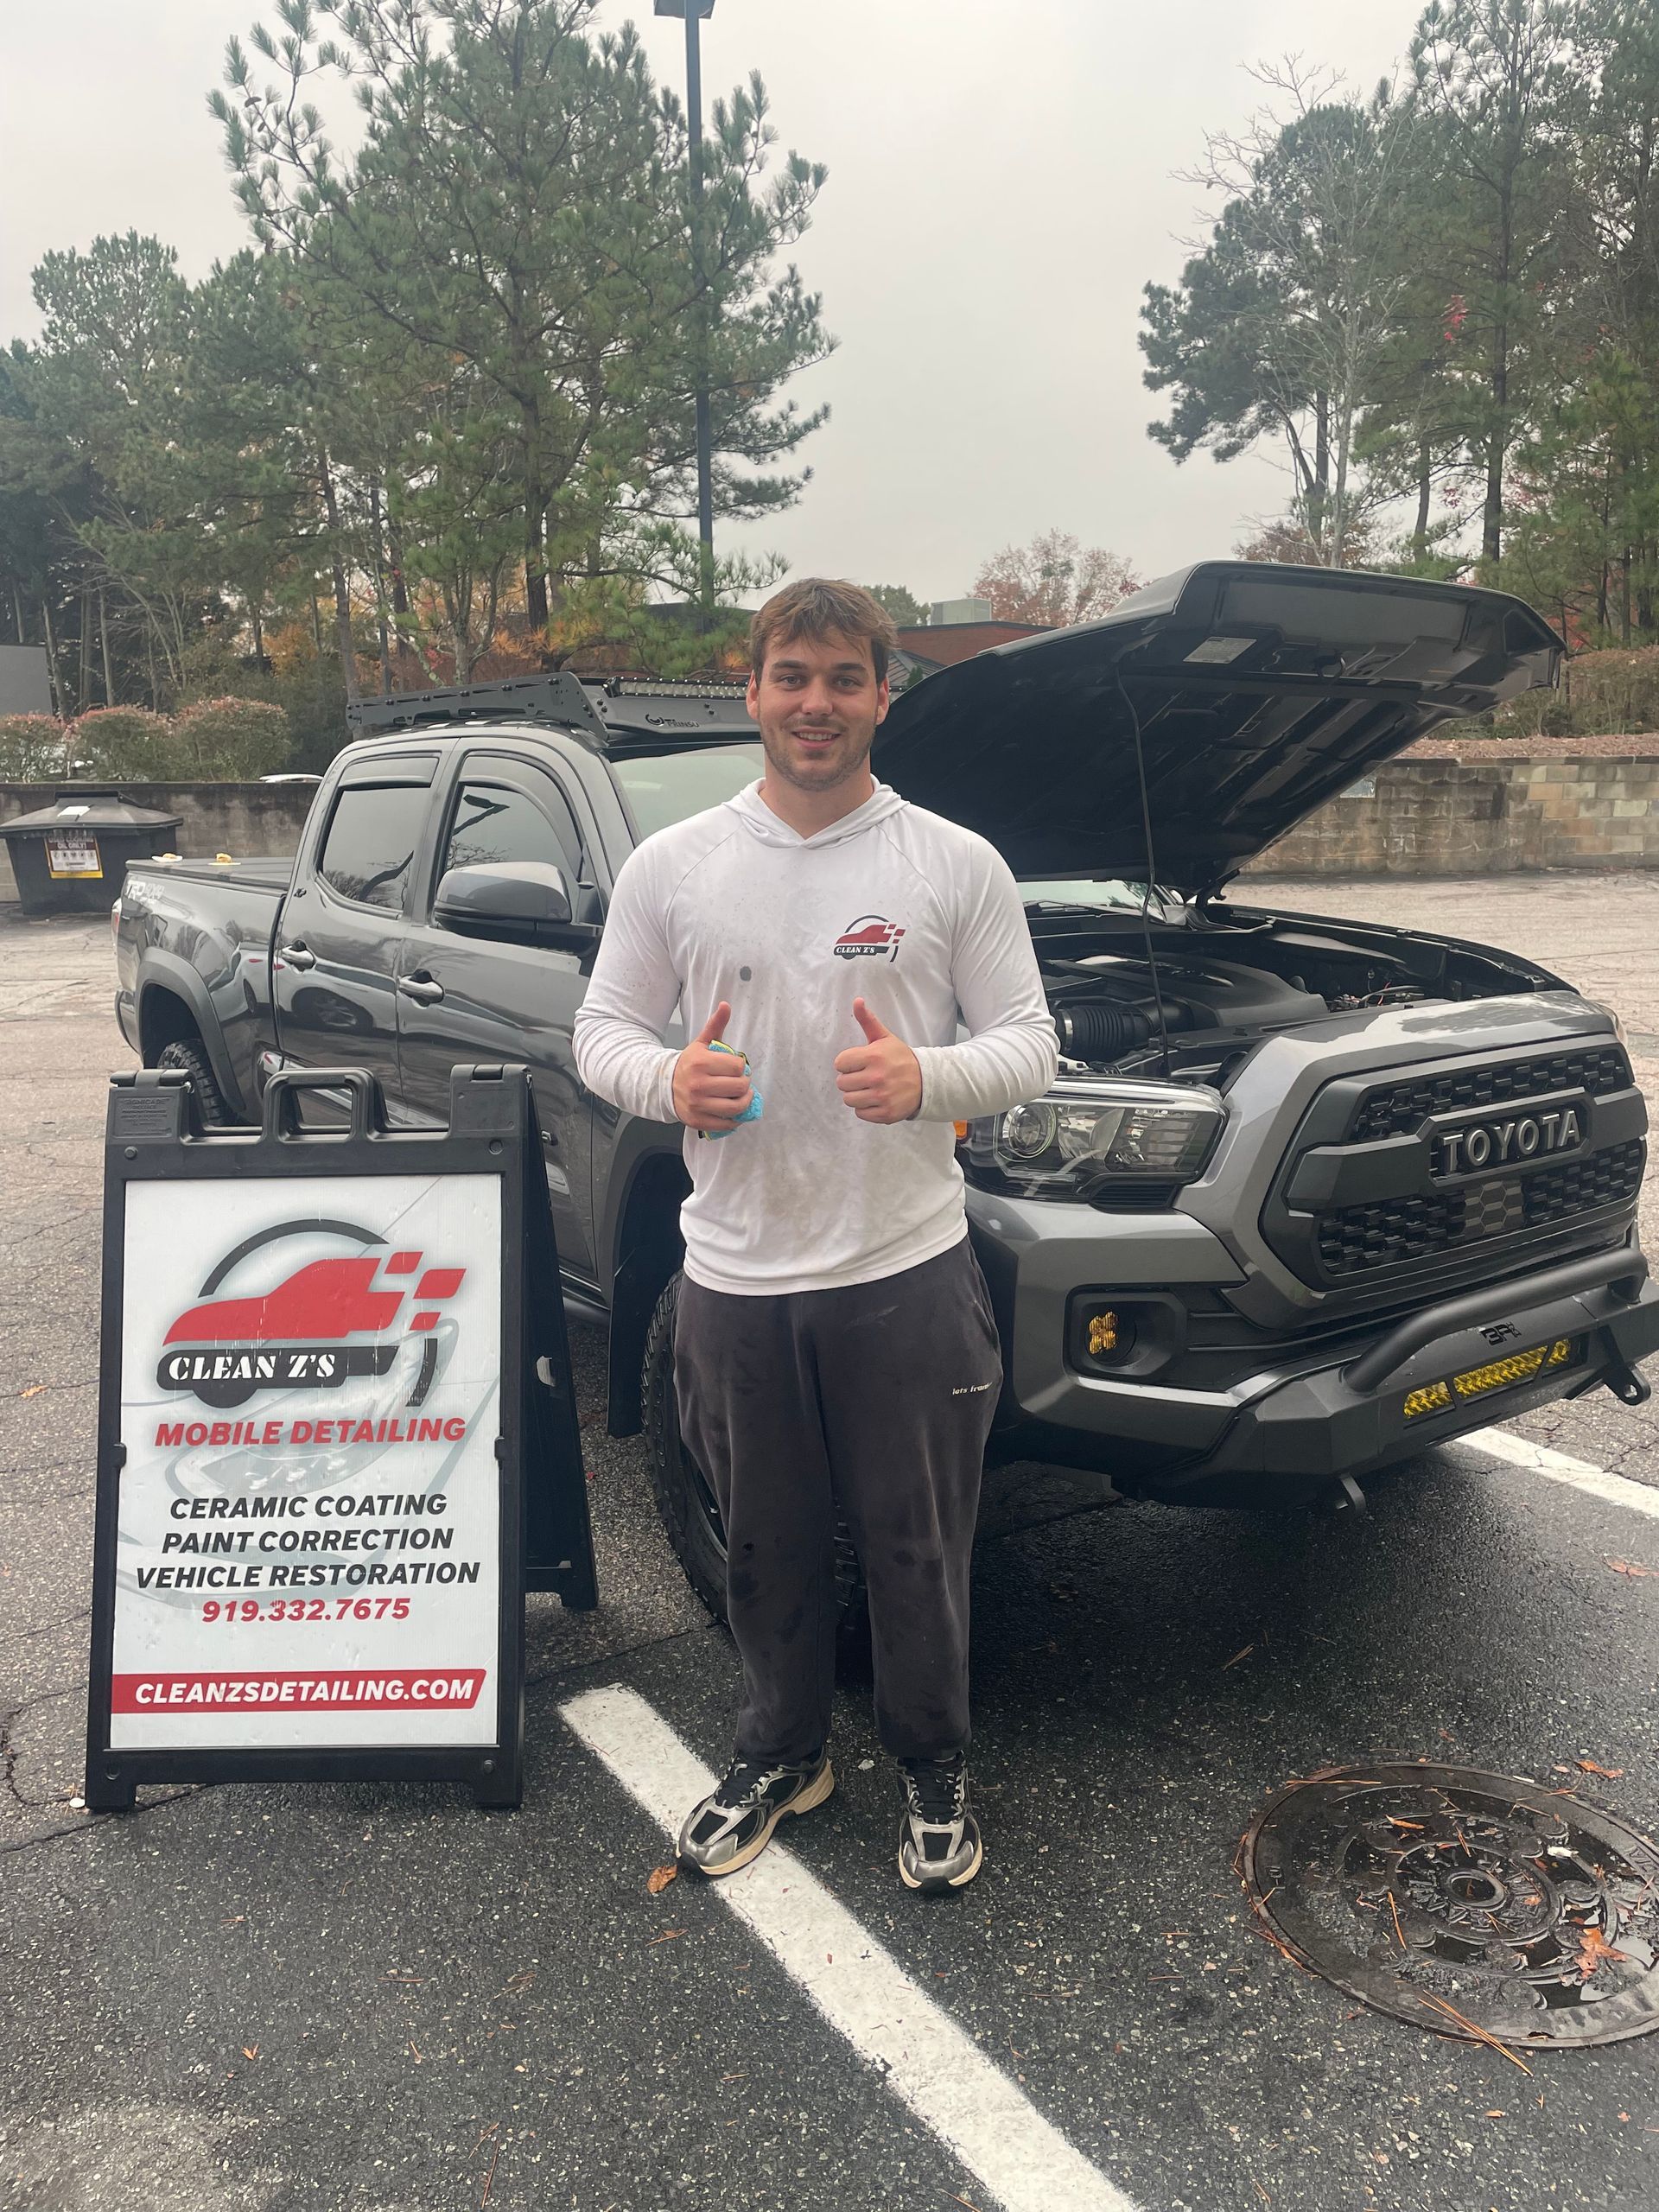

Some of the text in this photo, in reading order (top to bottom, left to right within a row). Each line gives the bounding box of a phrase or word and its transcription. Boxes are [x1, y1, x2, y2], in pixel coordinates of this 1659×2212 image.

[1440, 1109, 1581, 1172] TOYOTA
[168, 1354, 335, 1381] CLEAN Z'S
[155, 1418, 467, 1446] MOBILE DETAILING
[170, 1493, 448, 1520] CERAMIC COATING
[162, 1528, 454, 1554] PAINT CORRECTION
[137, 1561, 480, 1588] VEHICLE RESTORATION
[202, 1598, 411, 1623] 919.332.7675
[135, 1679, 474, 1705] CLEANZSDETAILING.COM
